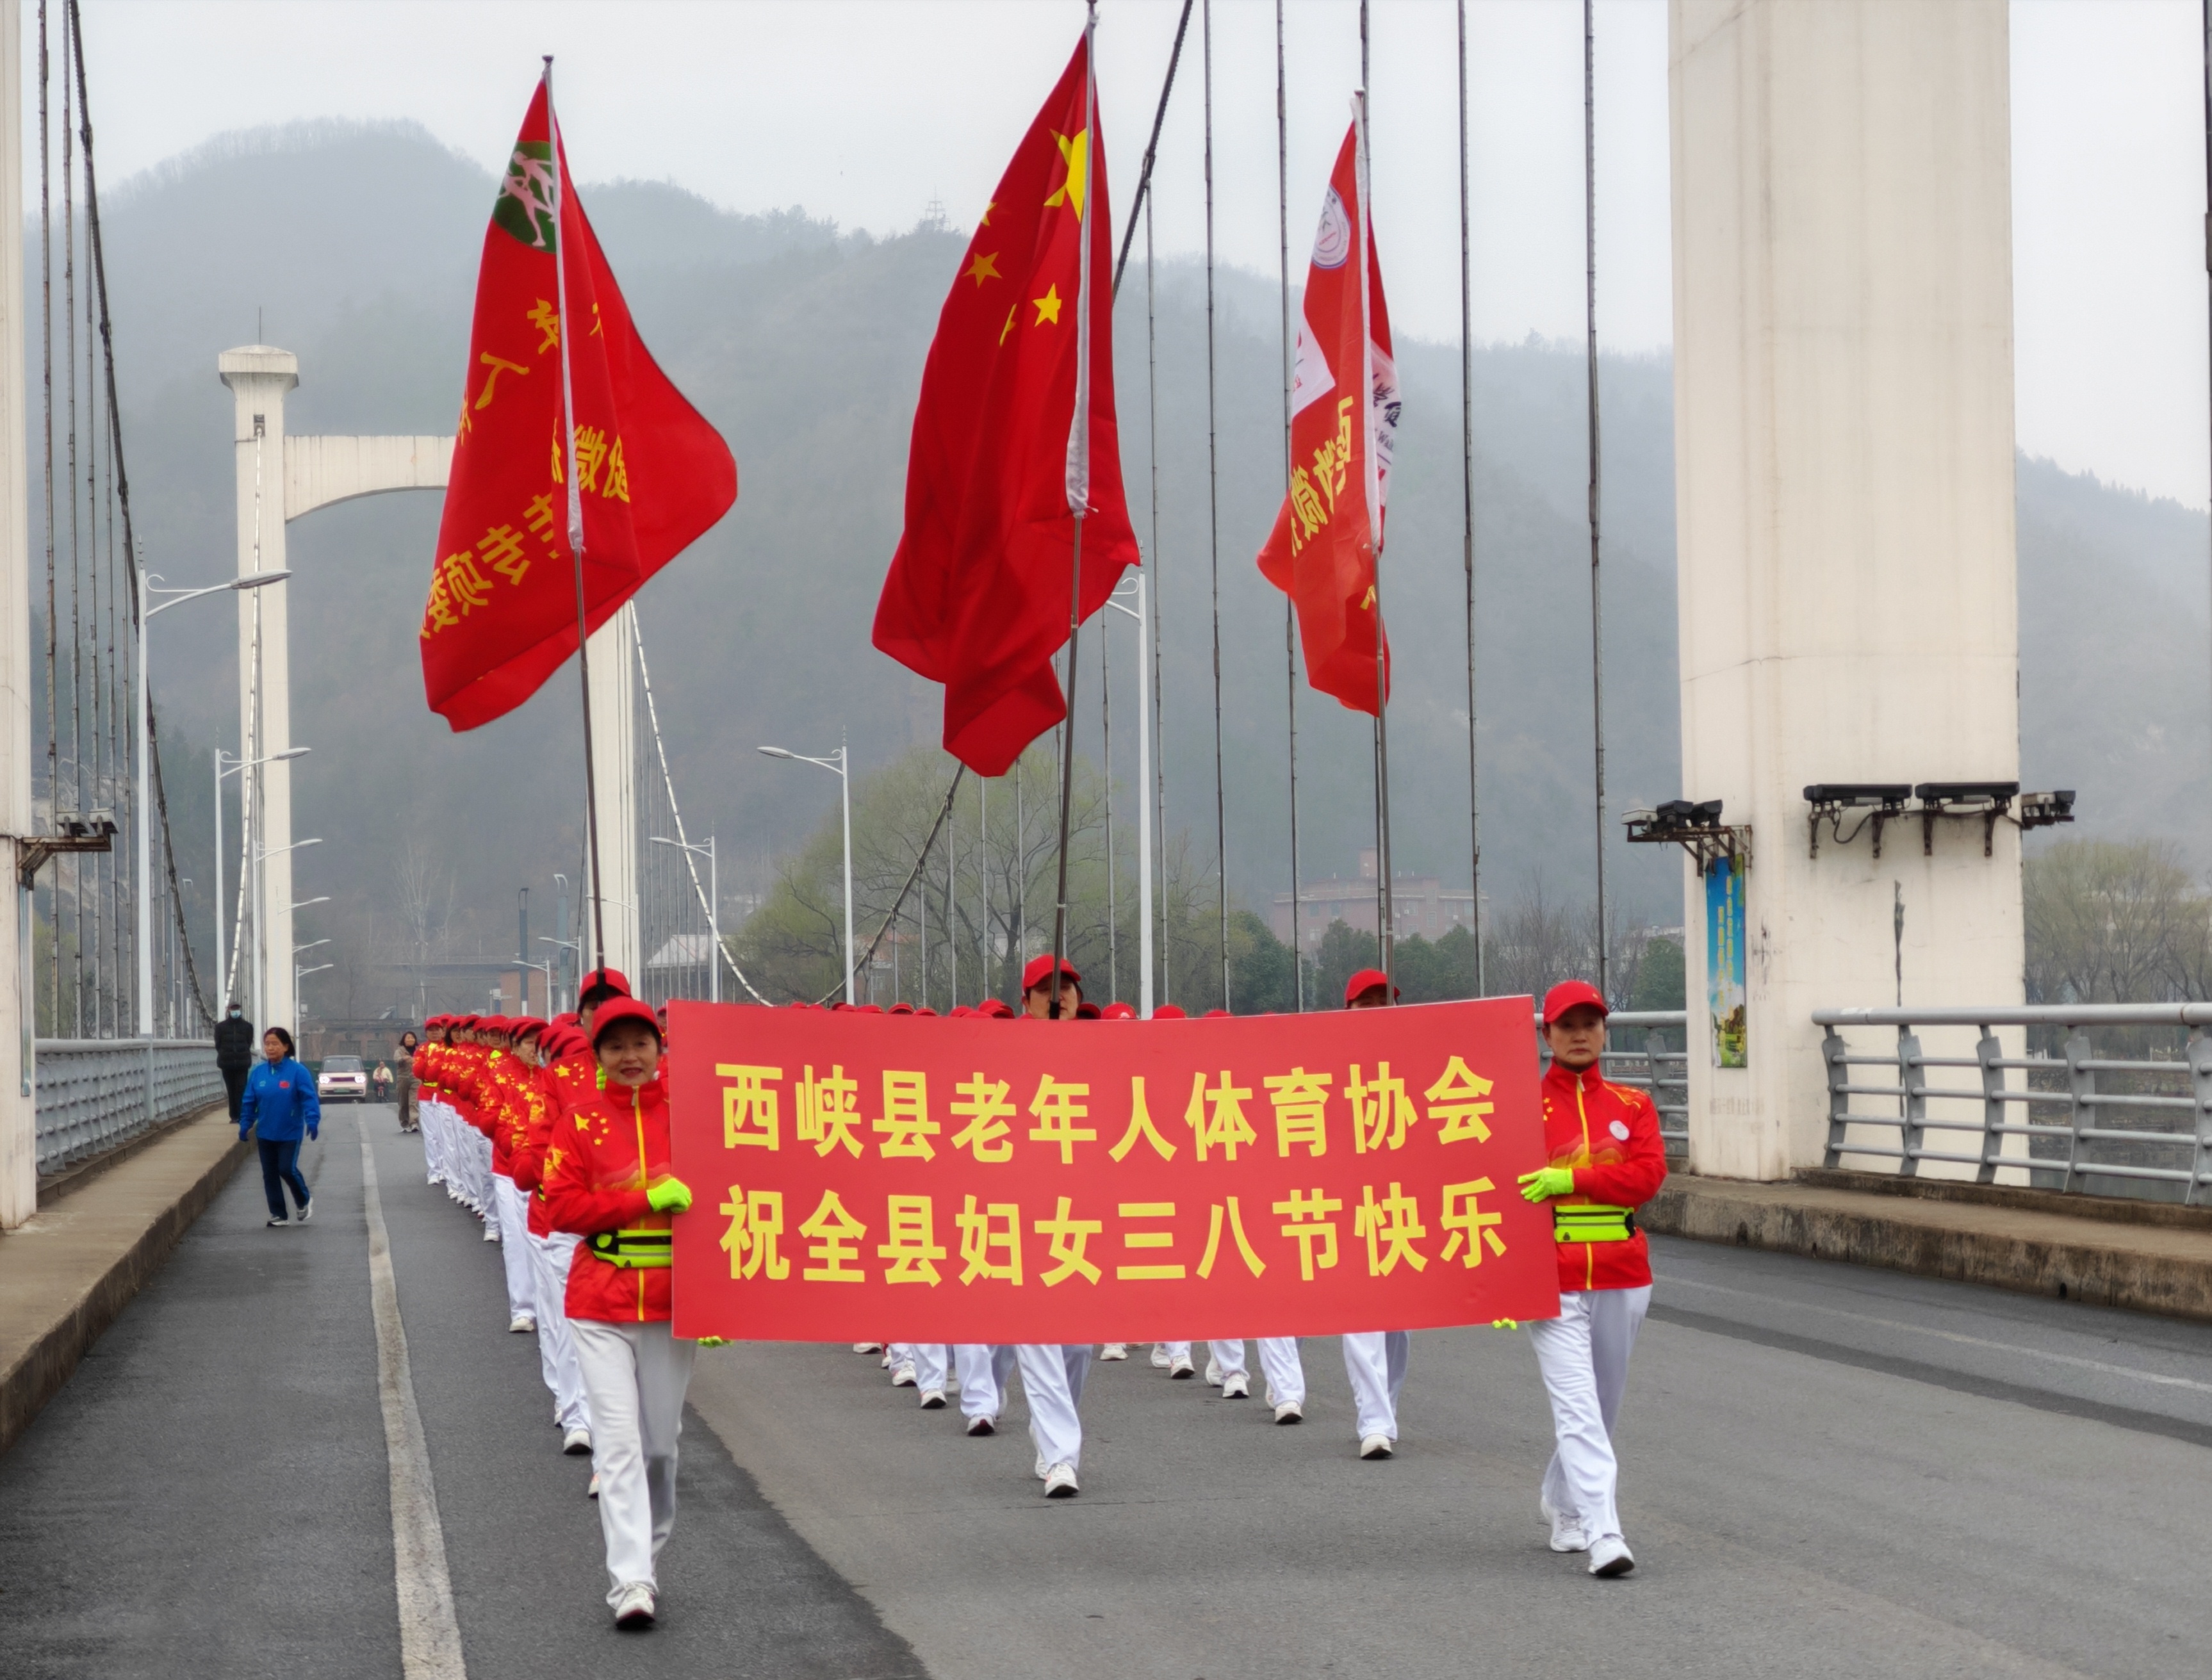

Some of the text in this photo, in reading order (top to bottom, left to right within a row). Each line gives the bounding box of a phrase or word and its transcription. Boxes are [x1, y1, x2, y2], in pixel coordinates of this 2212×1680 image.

[714, 1054, 1495, 1164] 西峡县老年人体育协会
[718, 1175, 1507, 1287] 祝全县妇女三八节快乐
